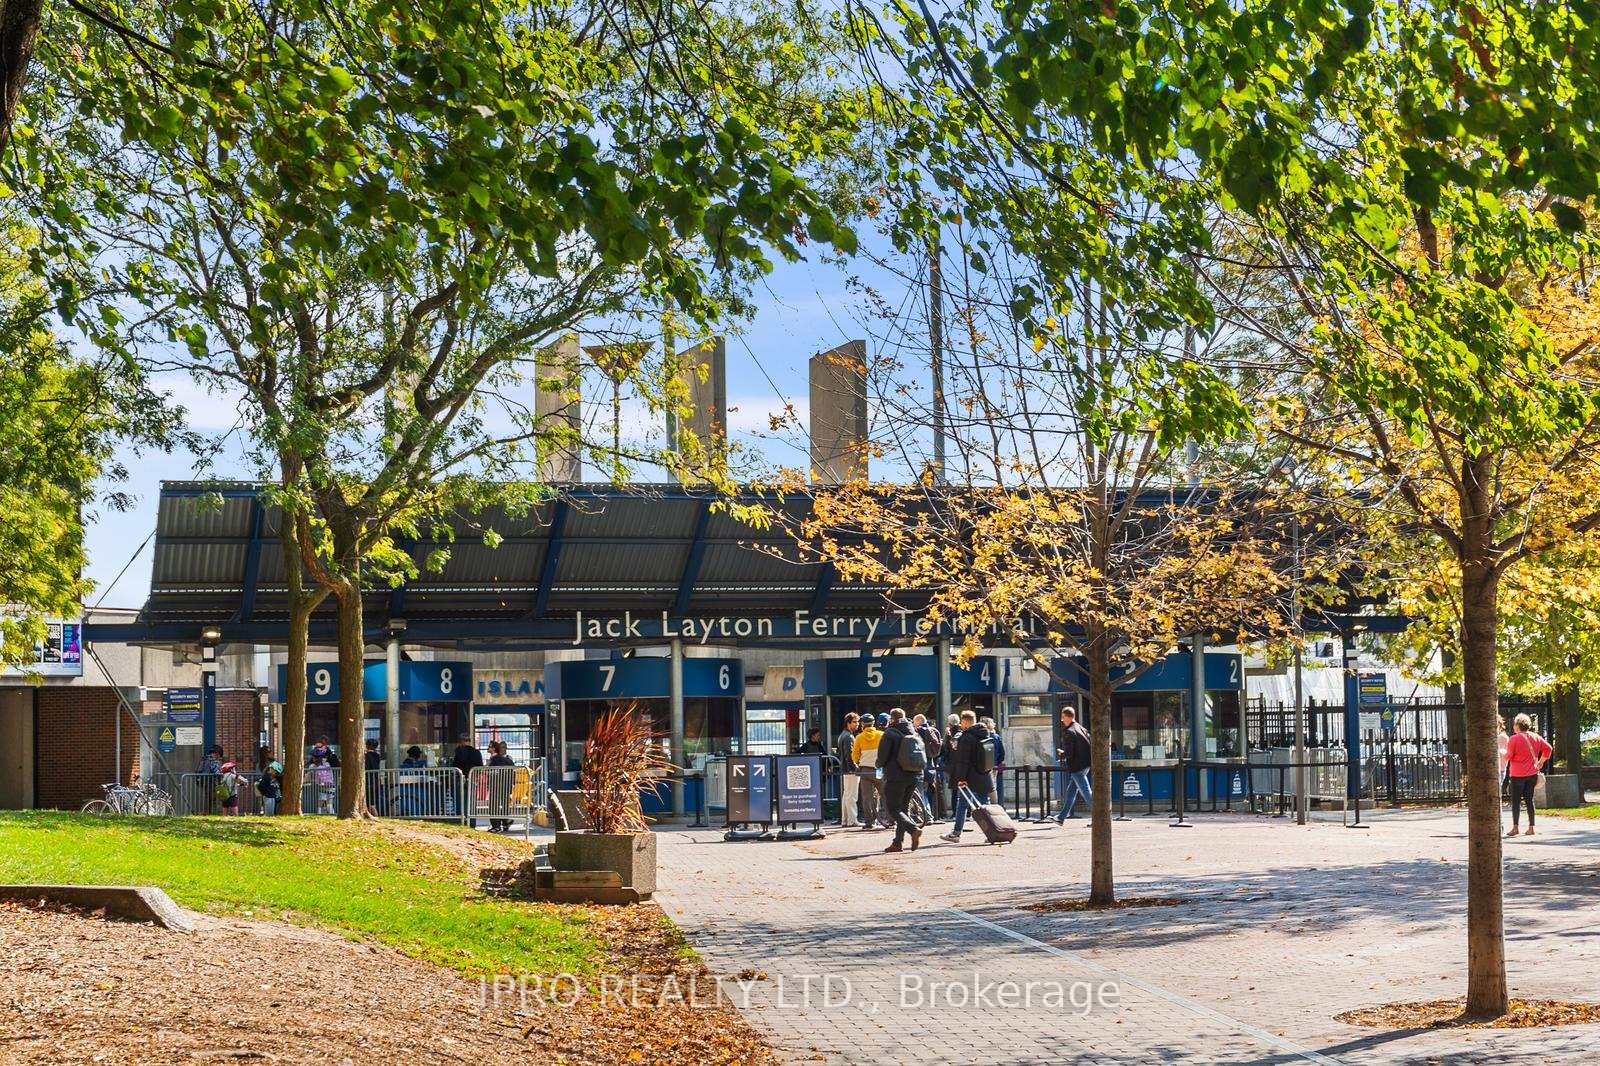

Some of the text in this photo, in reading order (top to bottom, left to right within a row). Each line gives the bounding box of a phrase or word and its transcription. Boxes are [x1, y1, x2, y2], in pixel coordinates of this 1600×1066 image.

[573, 610, 1035, 645] Jack Layton Ferry Termal
[314, 669, 330, 695] 9
[440, 668, 452, 694] 8
[599, 665, 615, 692] 7
[719, 665, 730, 690] 6
[867, 662, 883, 688] 5
[980, 662, 990, 686] 4
[1119, 661, 1137, 685] 3
[1229, 659, 1238, 683] 2
[783, 677, 804, 691] D
